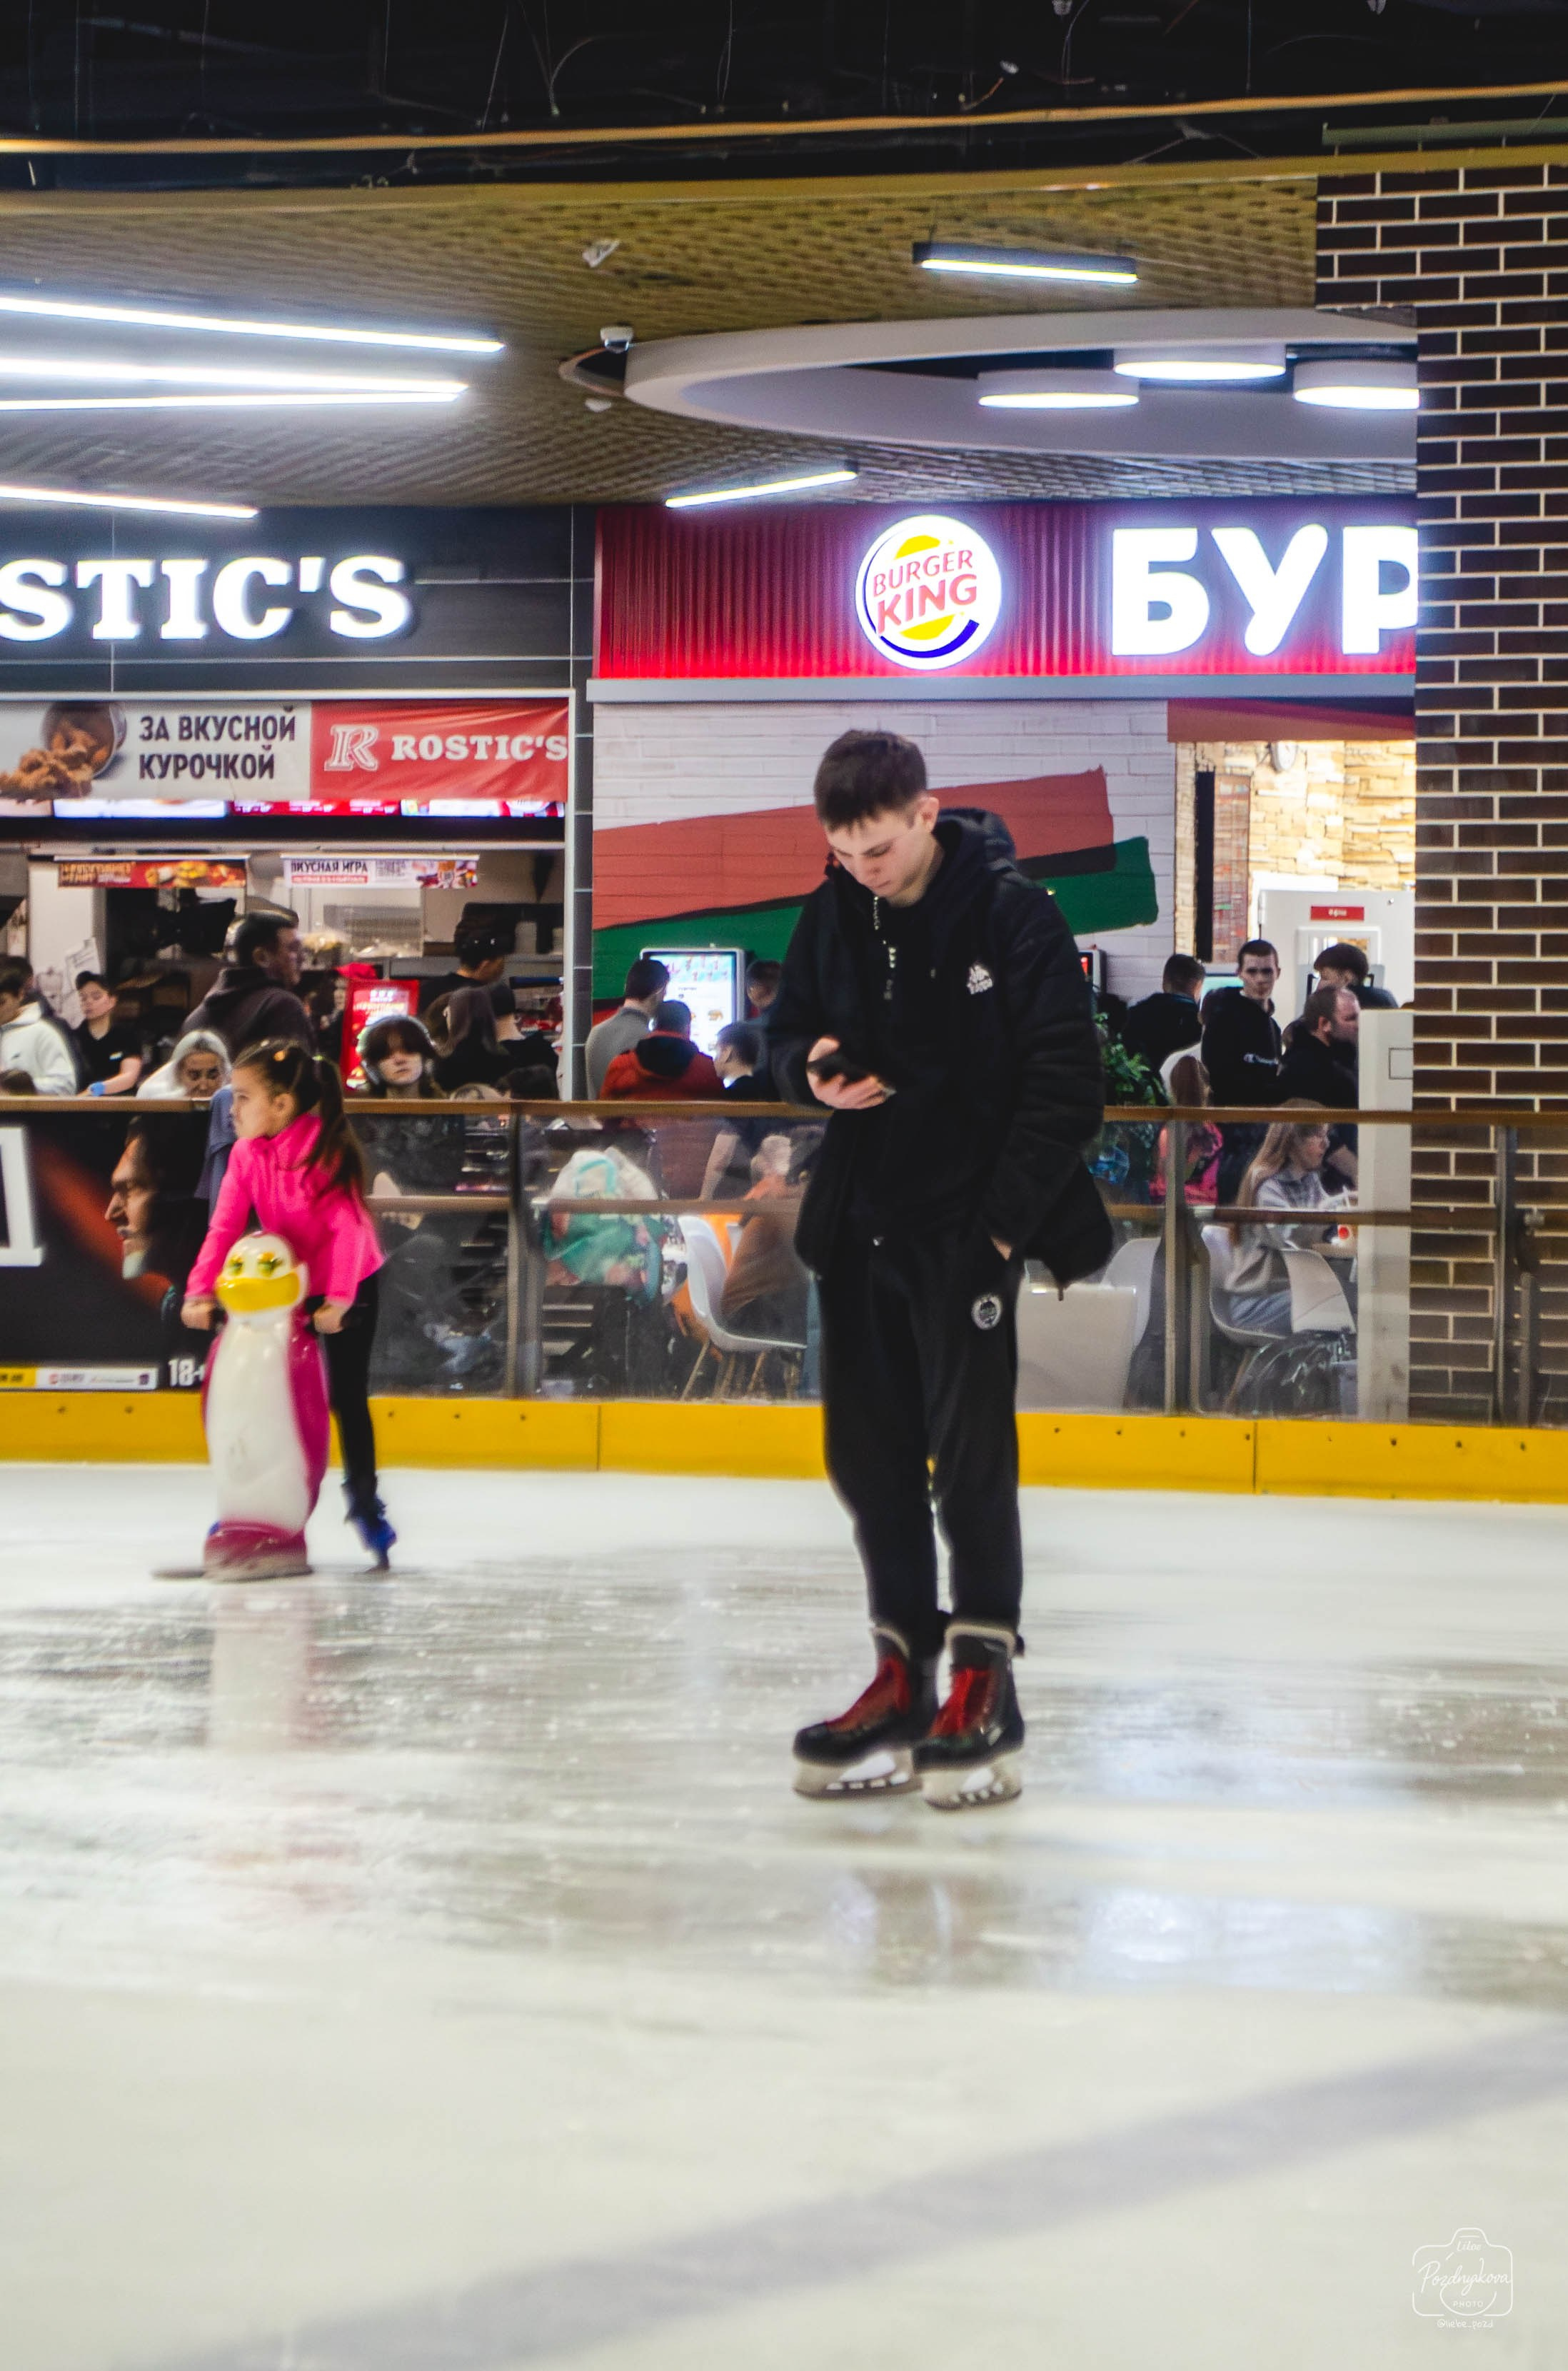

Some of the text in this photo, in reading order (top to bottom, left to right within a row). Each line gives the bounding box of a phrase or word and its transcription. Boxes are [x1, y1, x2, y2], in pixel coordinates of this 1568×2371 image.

[0, 554, 412, 641] STIC'S
[873, 549, 973, 598] BURGER
[1111, 523, 1418, 656] БУР
[877, 573, 978, 635] KING
[139, 705, 296, 742] ЗА ВКУСНОЙ
[391, 734, 568, 761] ROSTIC'S
[139, 744, 275, 781] КУРОЧКОЙ
